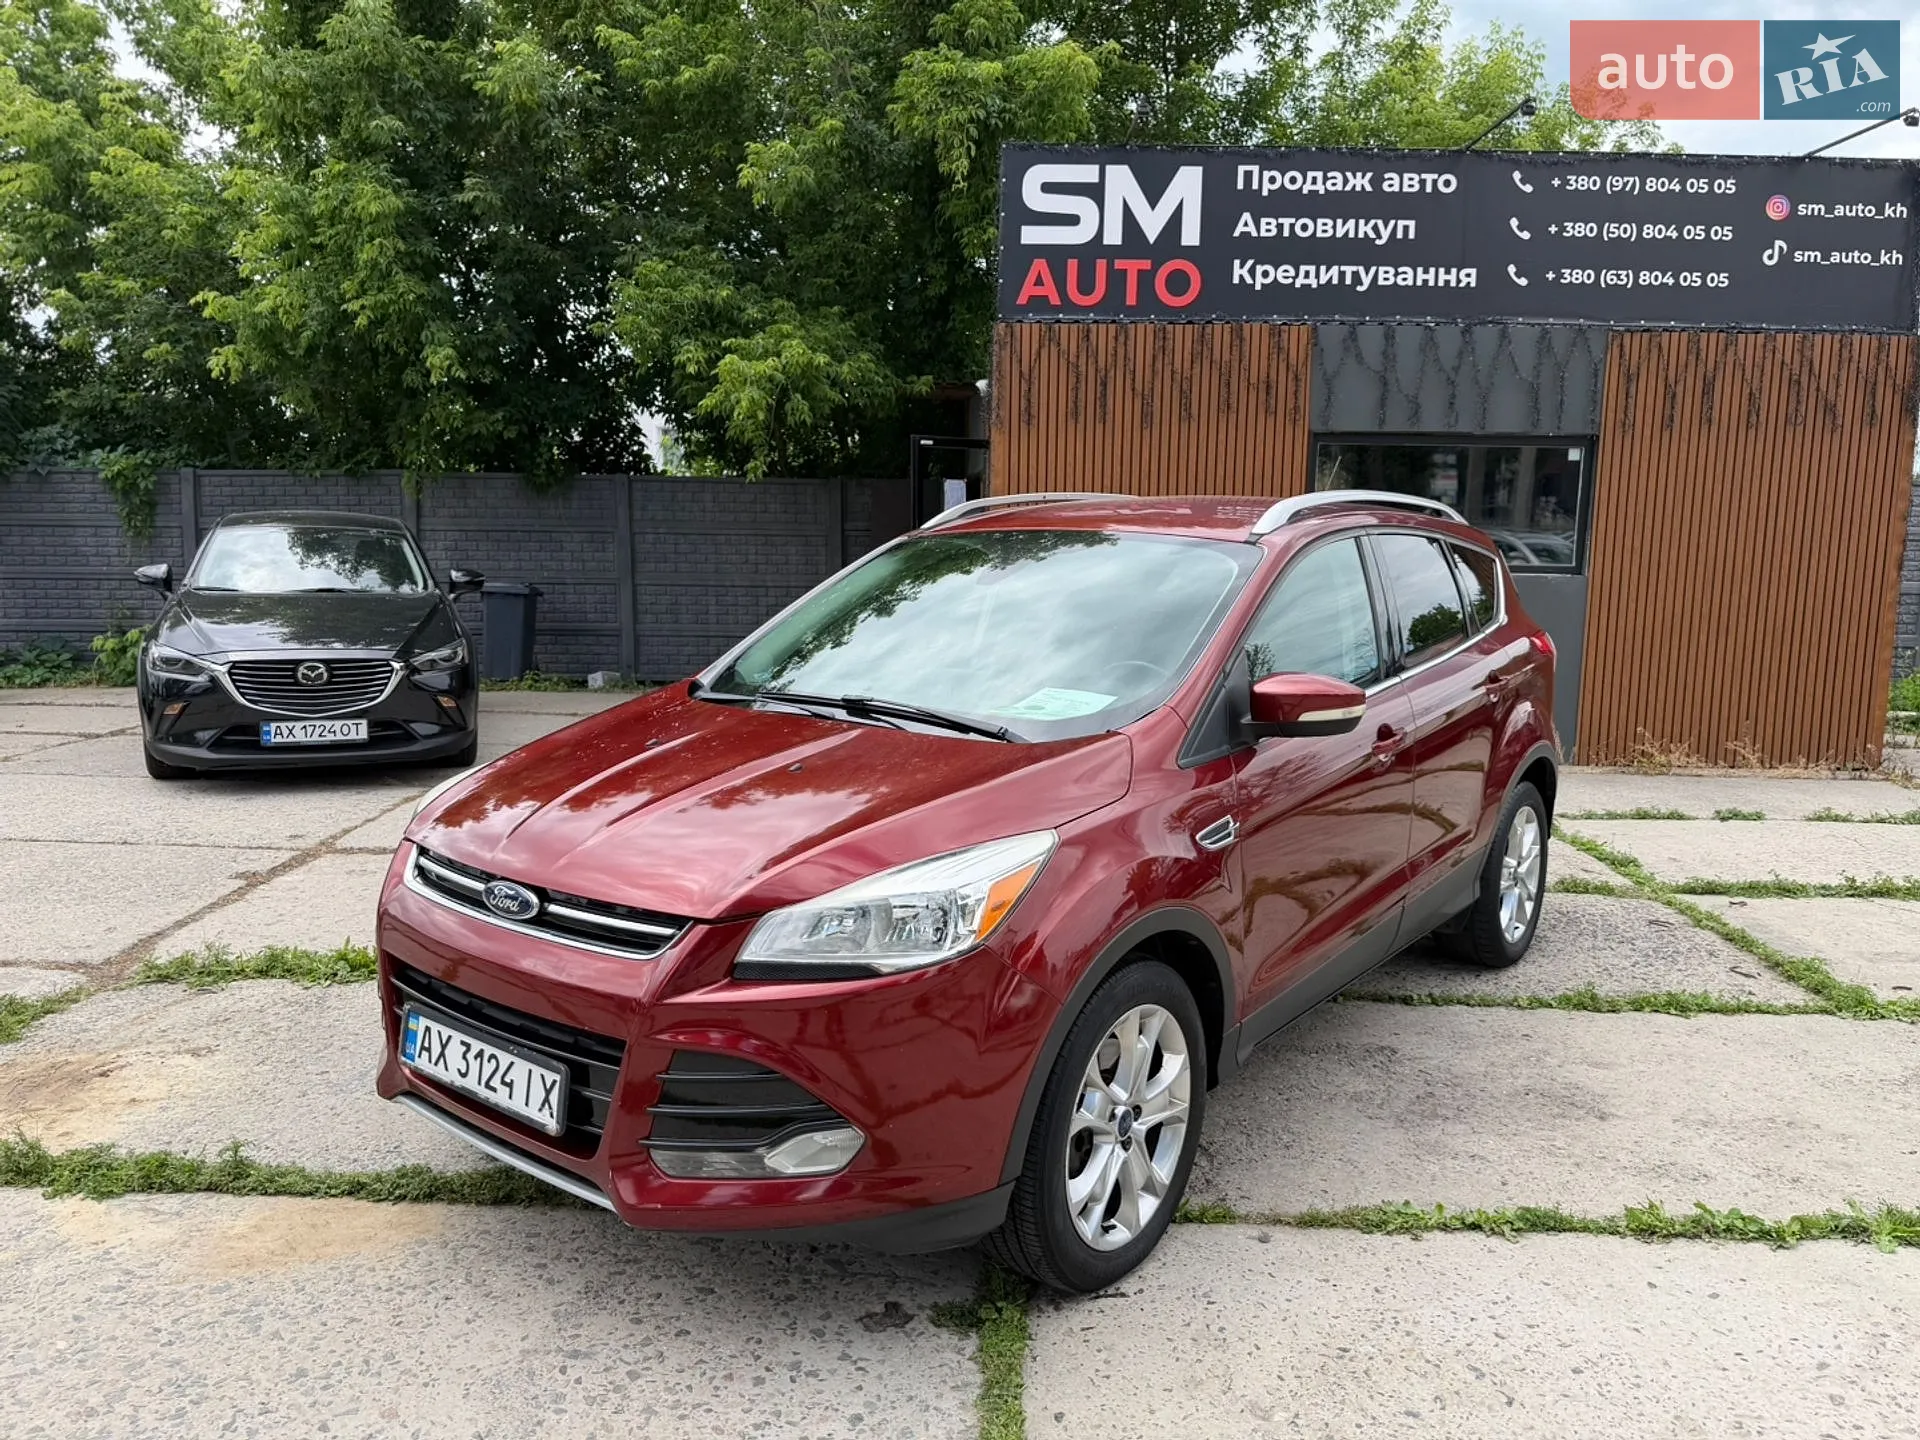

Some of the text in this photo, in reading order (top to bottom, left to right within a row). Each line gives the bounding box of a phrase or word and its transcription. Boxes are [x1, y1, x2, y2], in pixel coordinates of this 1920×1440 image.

[1236, 164, 1459, 197] Продаж авто
[1551, 175, 1737, 195] + 380 (97) 804 05 05
[1020, 164, 1203, 247] SM
[1797, 201, 1908, 220] sm_auto_kh
[1232, 211, 1417, 246] Автовикуп
[1547, 221, 1733, 242] + 380 (50) 804 05 05
[1793, 248, 1903, 267] sm_auto_kh
[1015, 258, 1203, 307] AUTO
[1232, 259, 1478, 292] Кредитування
[1545, 268, 1729, 289] + 380 (63) 804 05 05
[273, 725, 297, 740] AX
[300, 723, 337, 739] 1724
[340, 722, 363, 737] OT
[490, 885, 520, 912] Ford
[417, 1025, 559, 1120] AX 3124 IX
